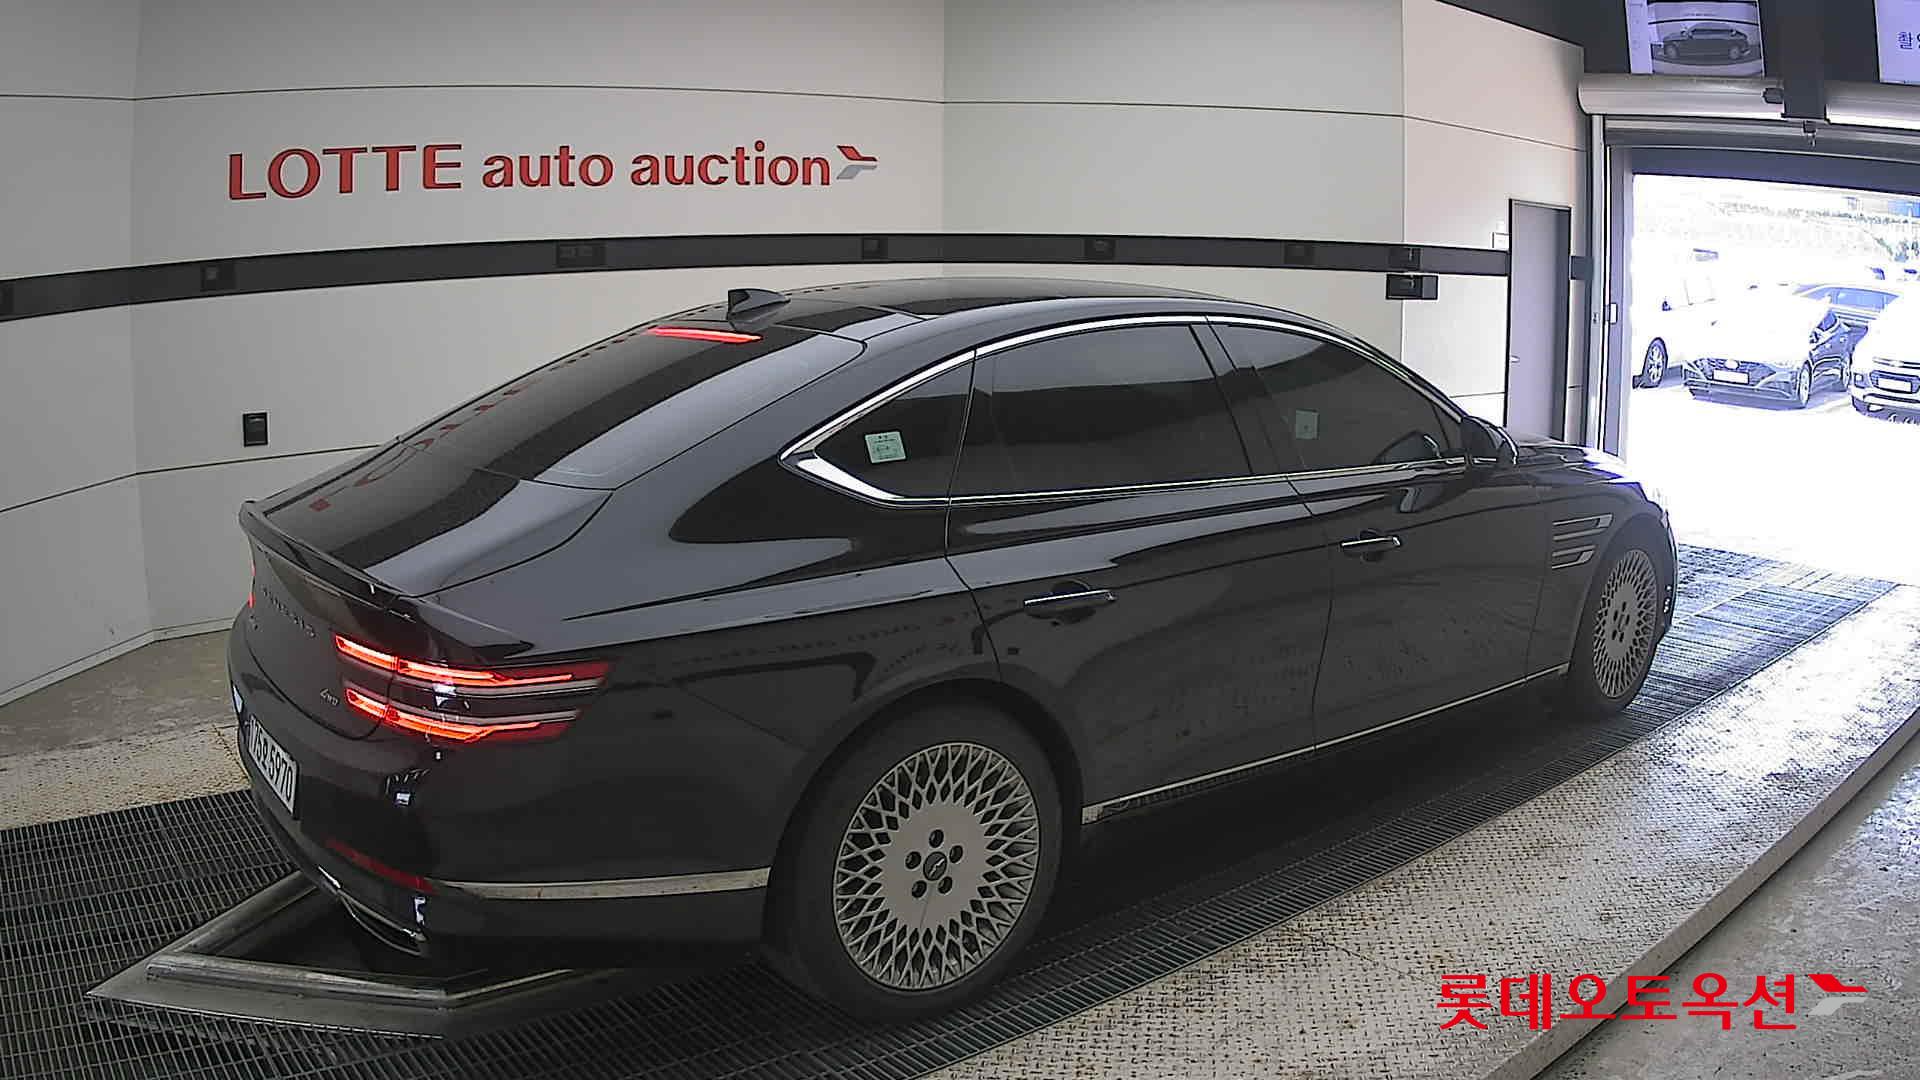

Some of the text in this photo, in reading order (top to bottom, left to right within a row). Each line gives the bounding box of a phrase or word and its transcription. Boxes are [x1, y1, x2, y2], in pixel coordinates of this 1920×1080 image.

[228, 140, 831, 200] LOTTE auto auction
